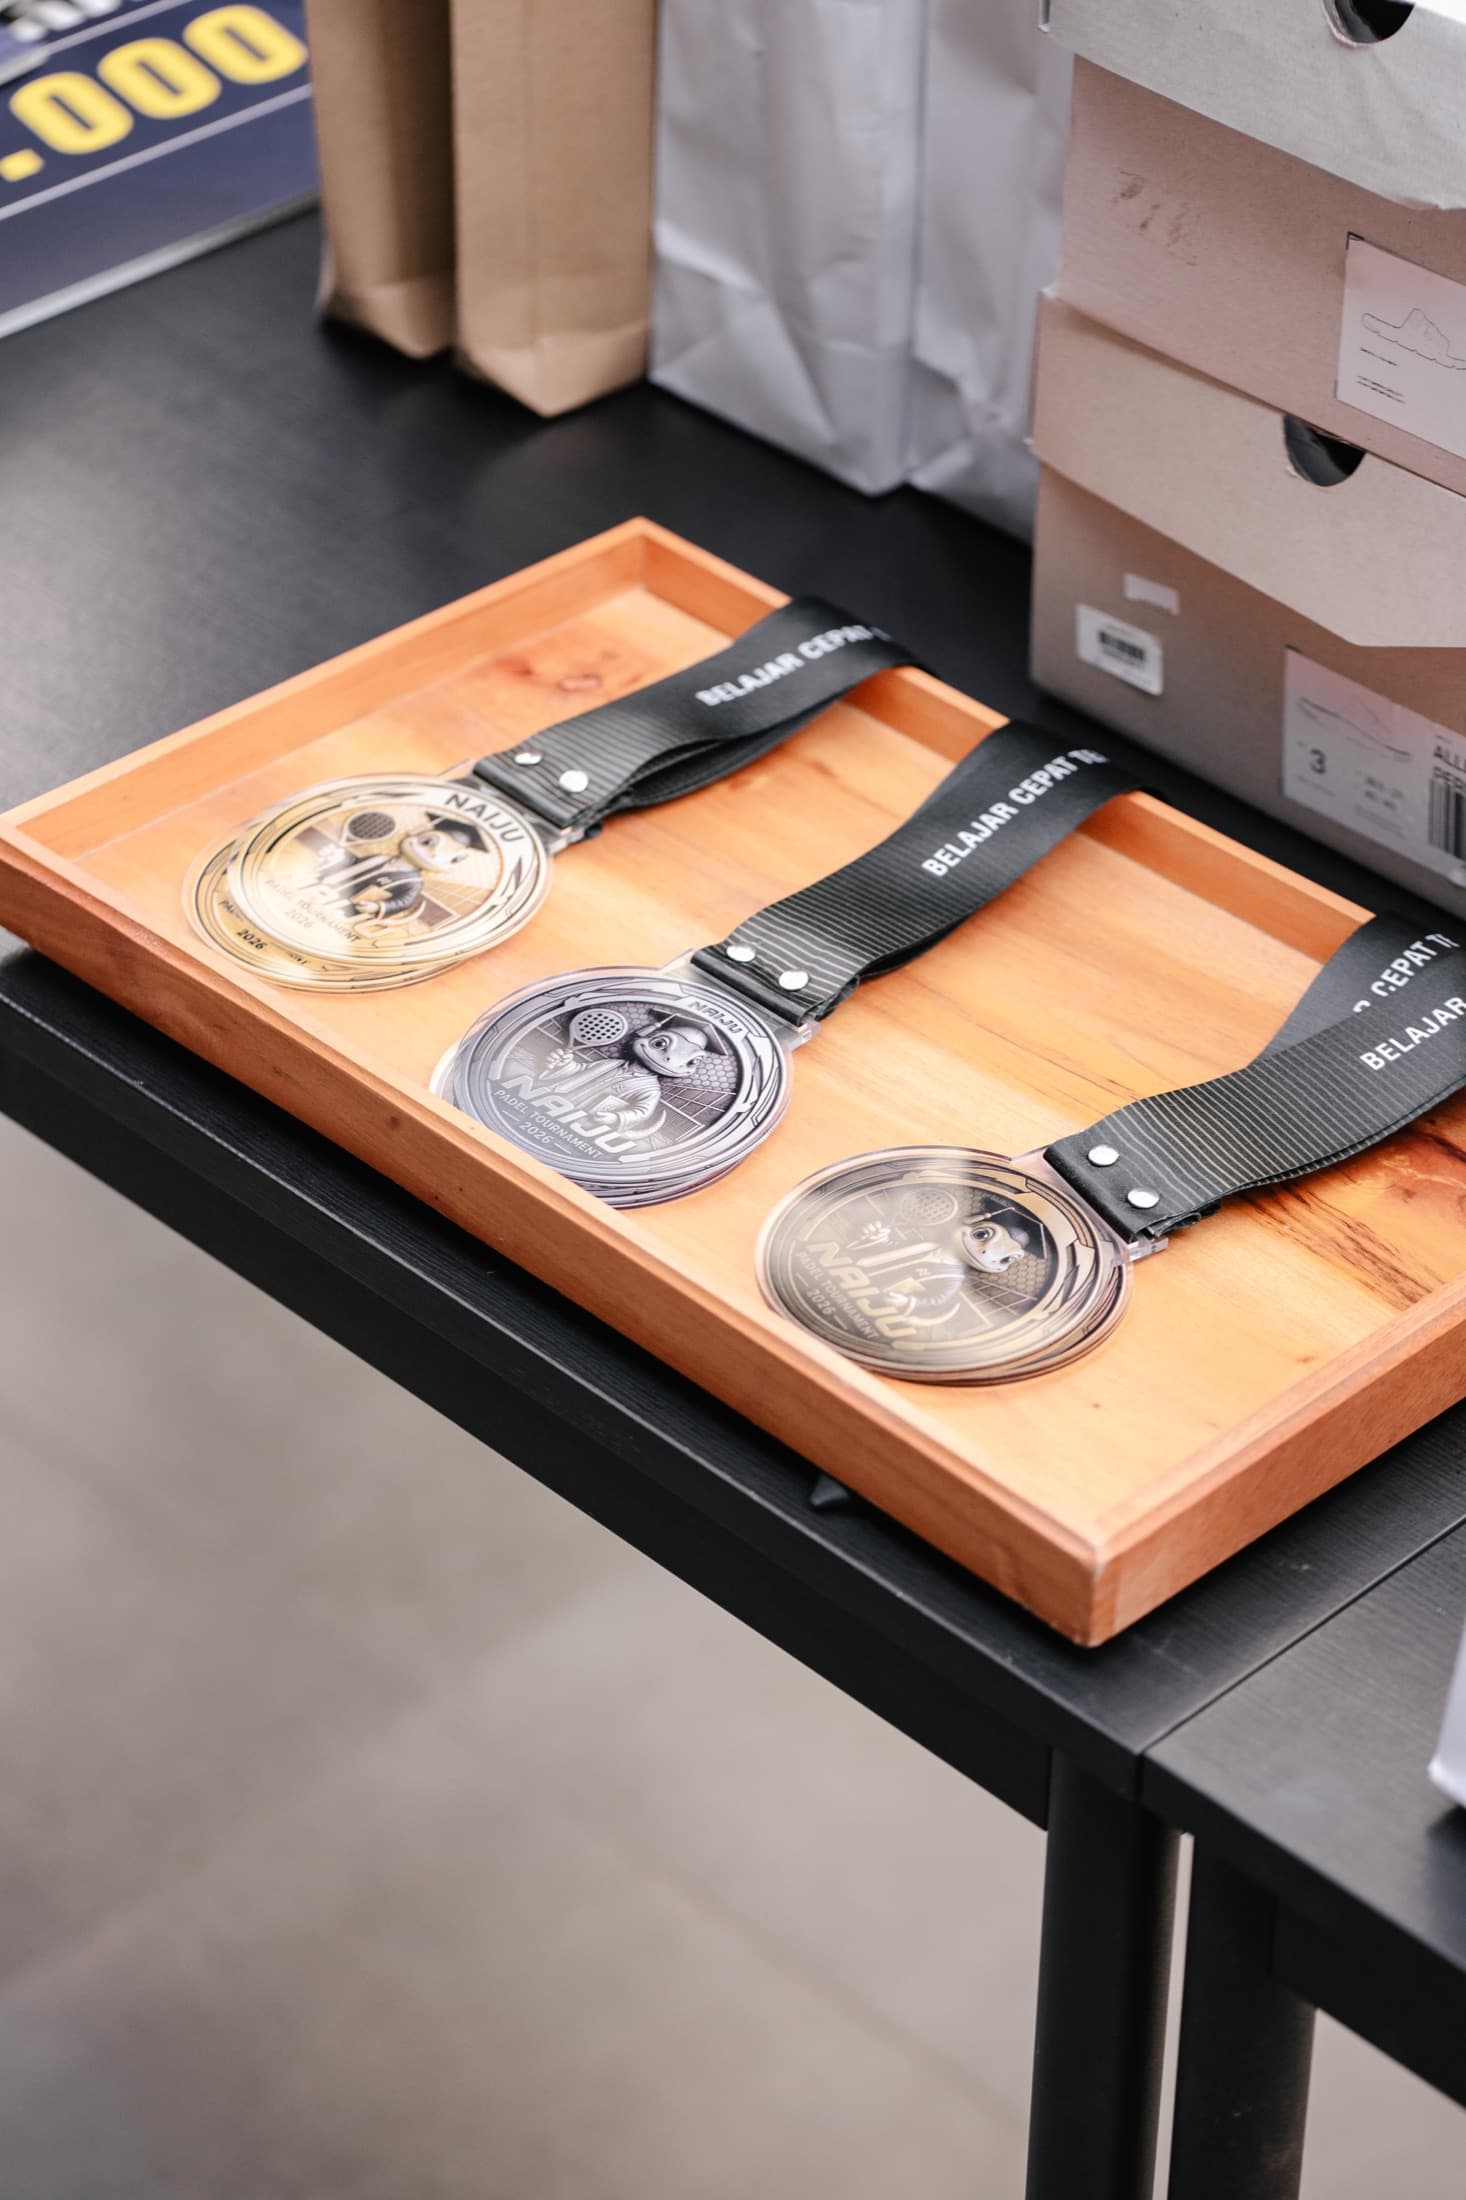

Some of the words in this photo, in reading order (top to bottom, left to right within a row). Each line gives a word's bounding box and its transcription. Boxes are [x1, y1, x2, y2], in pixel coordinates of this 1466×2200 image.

[696, 652, 804, 706] BELAJAR
[1310, 749, 1327, 775] 3
[445, 793, 525, 842] NAIJU
[921, 802, 1019, 877] BELAJAR
[1008, 756, 1078, 805] CEPAT
[235, 927, 269, 951] 2026
[1370, 940, 1438, 997] CEPAT
[688, 1001, 743, 1034] NAIJU
[1359, 997, 1466, 1071] BELAJAR
[493, 1089, 530, 1114] PADEL
[529, 1111, 605, 1159] TOURNAMENT
[501, 1075, 638, 1154] NAIJU
[519, 1121, 555, 1145] 2026
[796, 1251, 825, 1281] PADEL
[820, 1279, 880, 1340] TOURNAMENT
[805, 1241, 917, 1338] NAIJU
[806, 1288, 837, 1316] 2026
